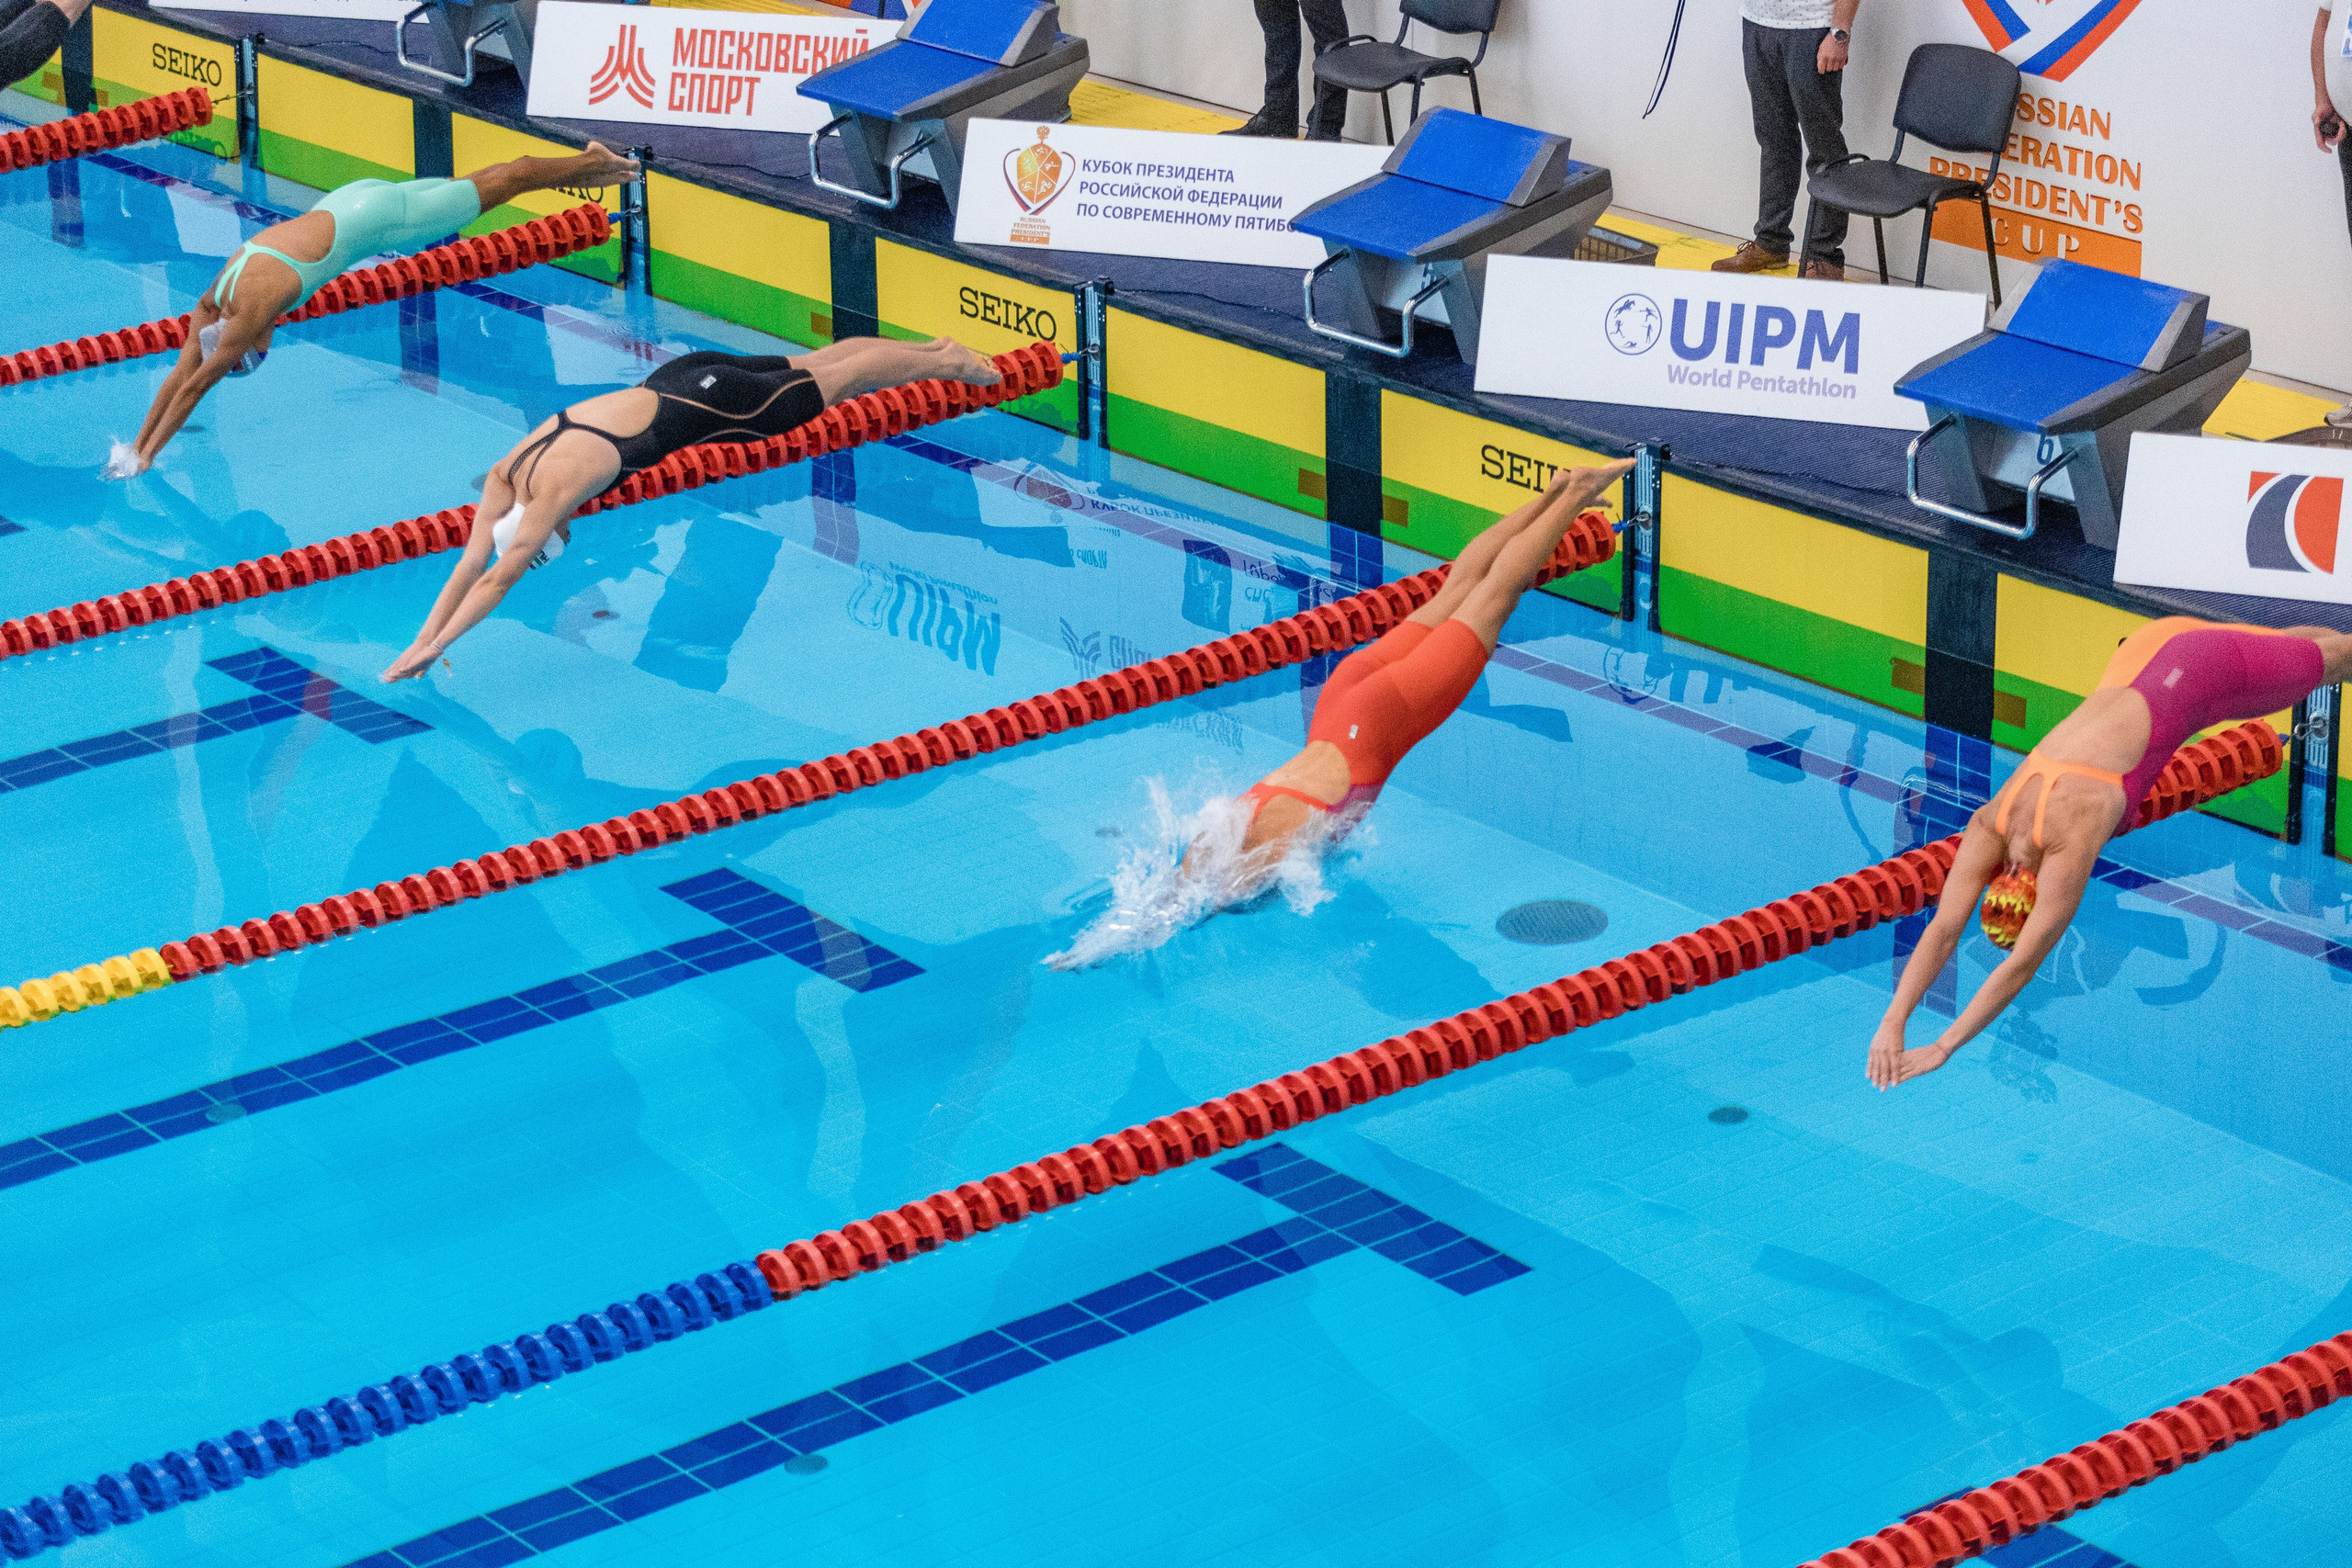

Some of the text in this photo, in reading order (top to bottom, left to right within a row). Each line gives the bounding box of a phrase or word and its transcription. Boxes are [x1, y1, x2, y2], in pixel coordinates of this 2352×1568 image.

[152, 42, 222, 87] SEIKO
[673, 28, 869, 75] МОСКОВСКИЙ
[668, 72, 762, 116] СПОРТ
[2015, 93, 2111, 141] SSIAN
[1082, 159, 1235, 183] КУБОК ПРЕЗИДЕНТА
[2001, 133, 2142, 191] ERATION
[1077, 203, 1100, 217] ПО
[1102, 205, 1232, 228] СОВРЕМЕННОМУ
[1080, 181, 1283, 211] РОССИЙСКОЙ ФЕДЕРАЦИИ
[1013, 222, 1051, 231] FEDERATION
[959, 286, 1057, 343] SEIKO
[1669, 298, 1860, 375] UIPM
[1668, 365, 1858, 400] World Pentathlon
[1481, 444, 1562, 494] SEI
